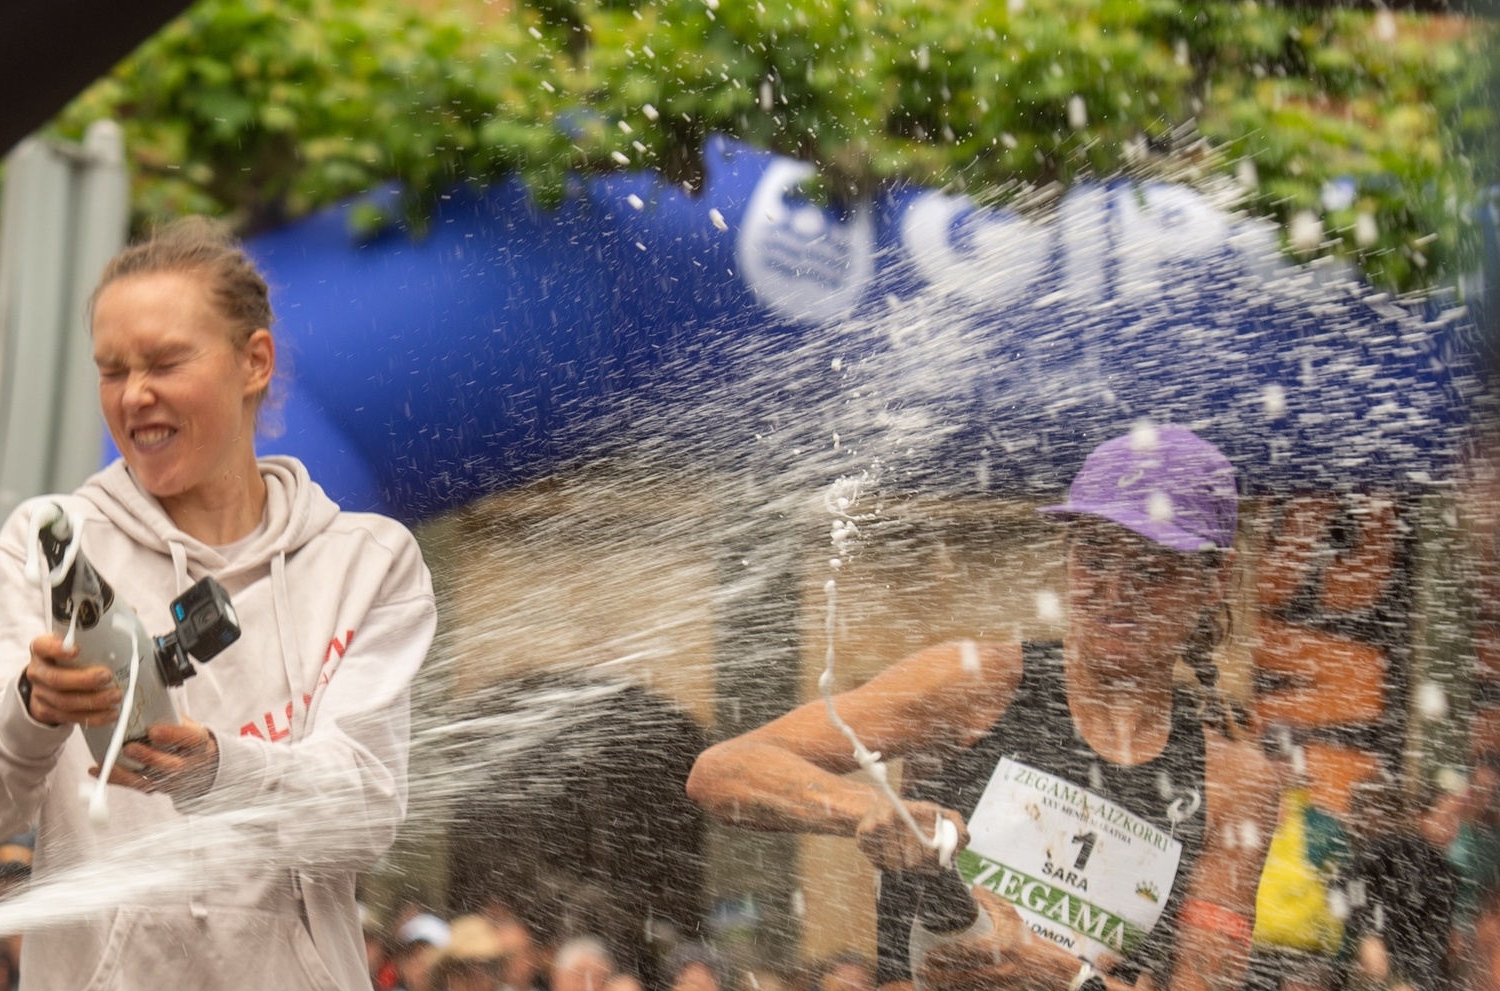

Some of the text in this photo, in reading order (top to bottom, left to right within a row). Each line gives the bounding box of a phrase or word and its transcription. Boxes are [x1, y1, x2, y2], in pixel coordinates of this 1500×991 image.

[1013, 767, 1169, 853] ZEGAMA-AIZKORRI
[1041, 862, 1088, 893] SARA
[1071, 831, 1099, 871] 1
[972, 858, 1126, 951] ZEGAMA
